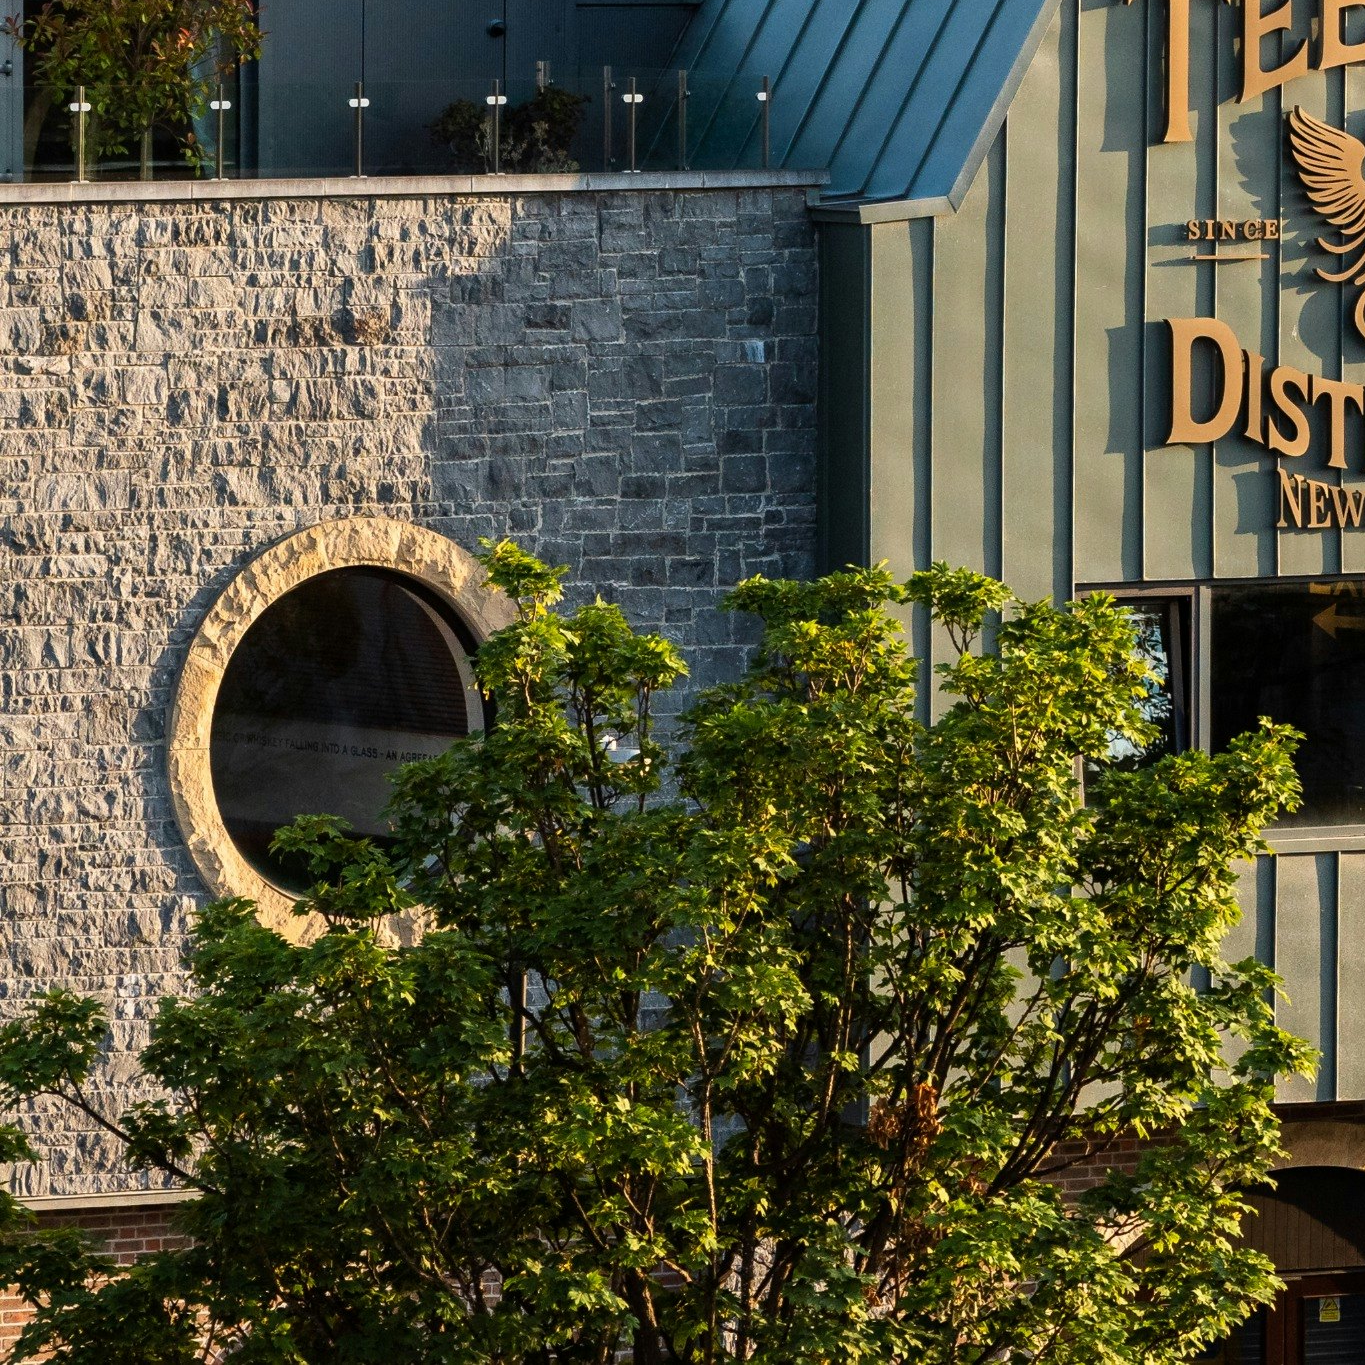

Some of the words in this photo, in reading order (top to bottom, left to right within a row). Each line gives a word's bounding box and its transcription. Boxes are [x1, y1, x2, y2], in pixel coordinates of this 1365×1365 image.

[1187, 219, 1279, 240] SINCE
[285, 739, 318, 752] FALLING
[351, 745, 378, 759] GLASS
[386, 750, 397, 761] AN
